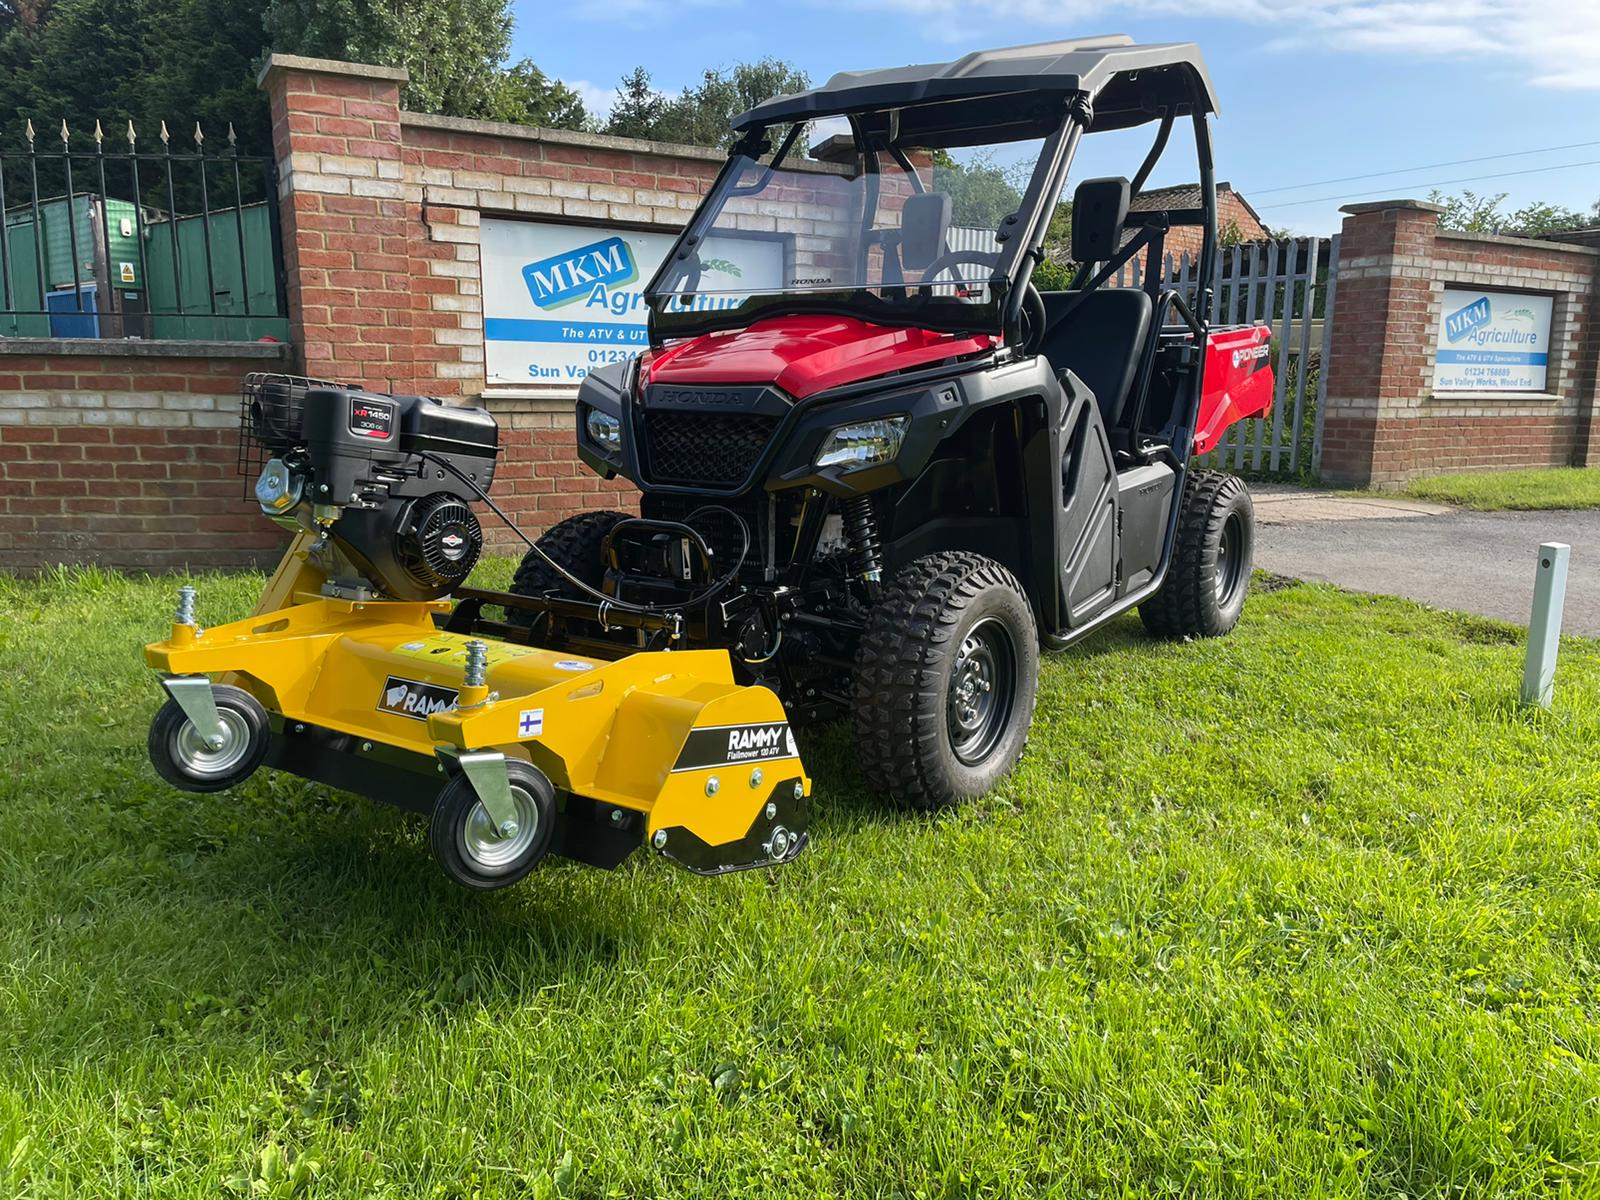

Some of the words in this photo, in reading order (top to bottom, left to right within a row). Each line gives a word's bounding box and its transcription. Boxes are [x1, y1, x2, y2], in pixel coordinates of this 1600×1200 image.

[530, 244, 627, 299] MKM
[1448, 302, 1488, 337] MKM
[562, 328, 584, 338] The
[588, 330, 613, 339] ATV
[617, 331, 625, 339] &
[630, 331, 647, 340] UT
[1468, 326, 1537, 346] Agriculture
[1239, 344, 1269, 360] PIONEER
[528, 365, 560, 378] Sun
[565, 366, 591, 378] Val
[1465, 367, 1485, 376] 01234
[1439, 378, 1453, 386] Sun
[1455, 378, 1475, 388] Valley
[1520, 379, 1533, 387] End
[660, 391, 744, 406] HONDA
[403, 692, 459, 715] RAMM
[728, 727, 782, 750] RAMMY
[769, 746, 780, 755] ATV
